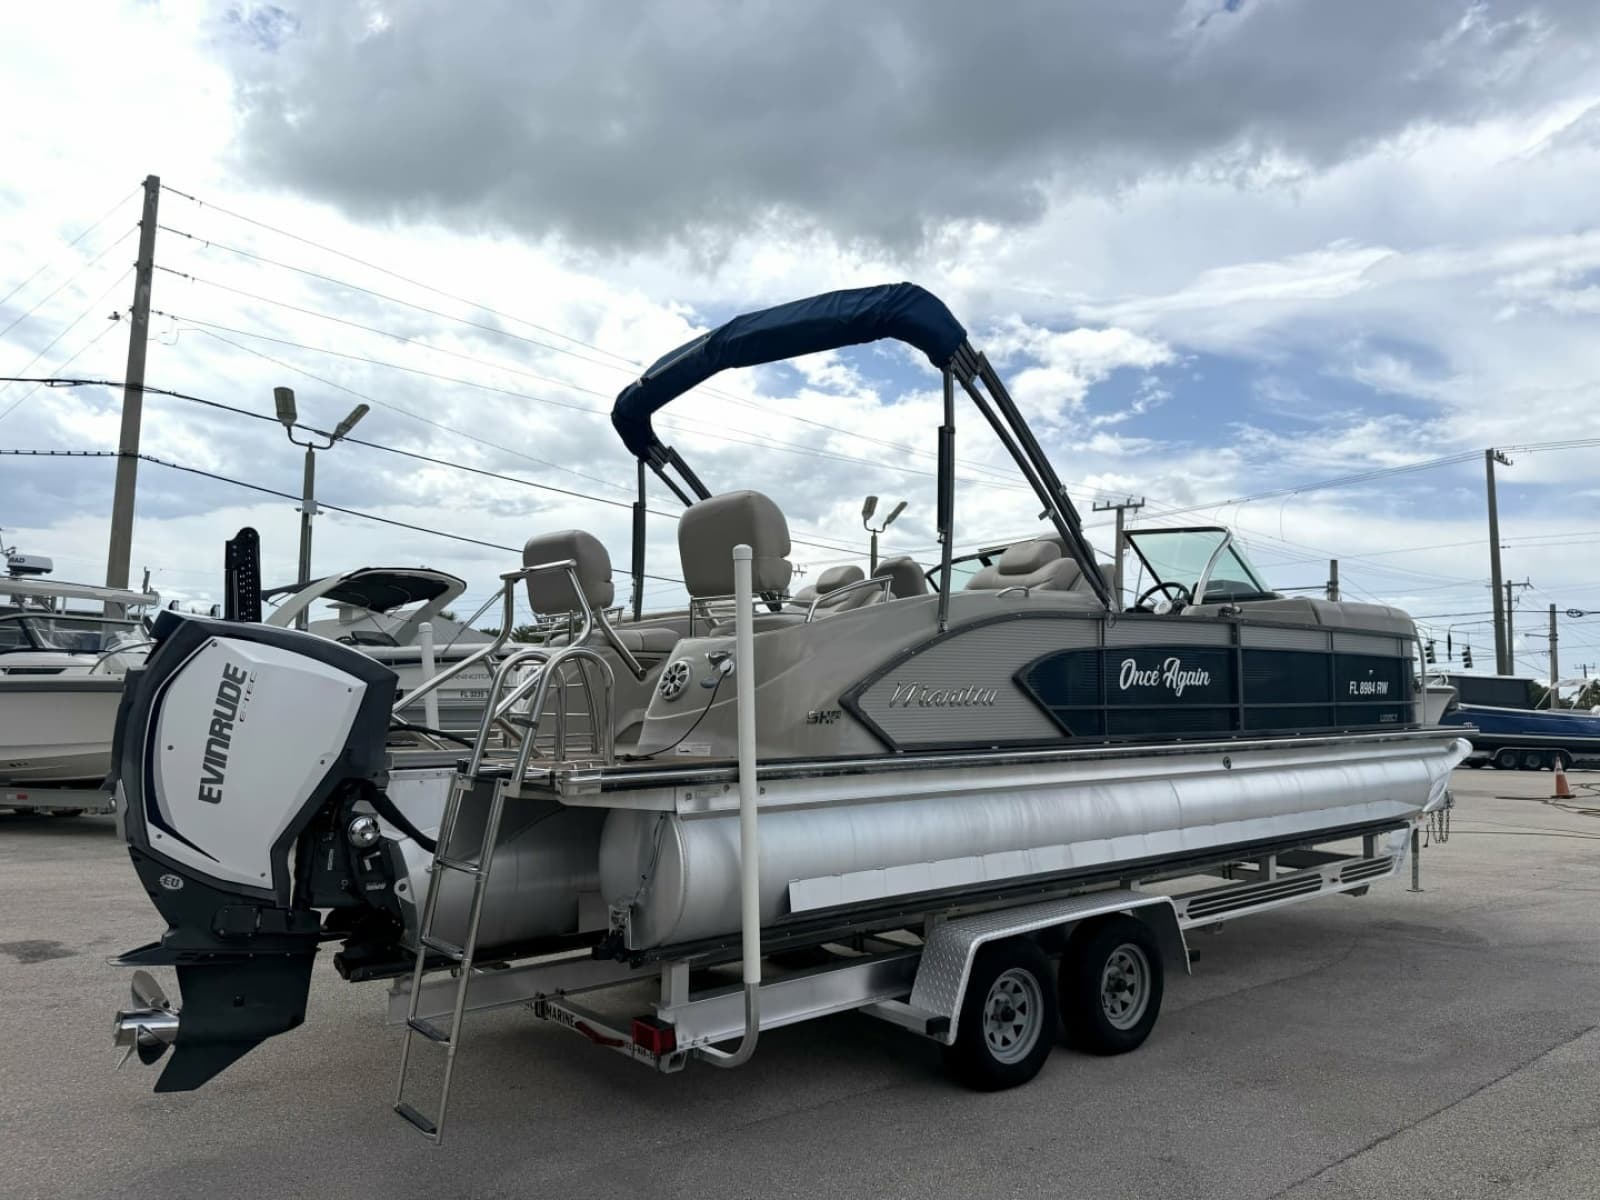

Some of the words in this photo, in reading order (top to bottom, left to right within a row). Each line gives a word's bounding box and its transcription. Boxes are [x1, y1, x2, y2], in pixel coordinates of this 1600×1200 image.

[1162, 656, 1211, 698] Again
[1348, 681, 1359, 696] FL
[1360, 681, 1376, 695] 8984
[198, 662, 248, 805] EVINRUDE
[546, 1004, 575, 1029] MARINE
